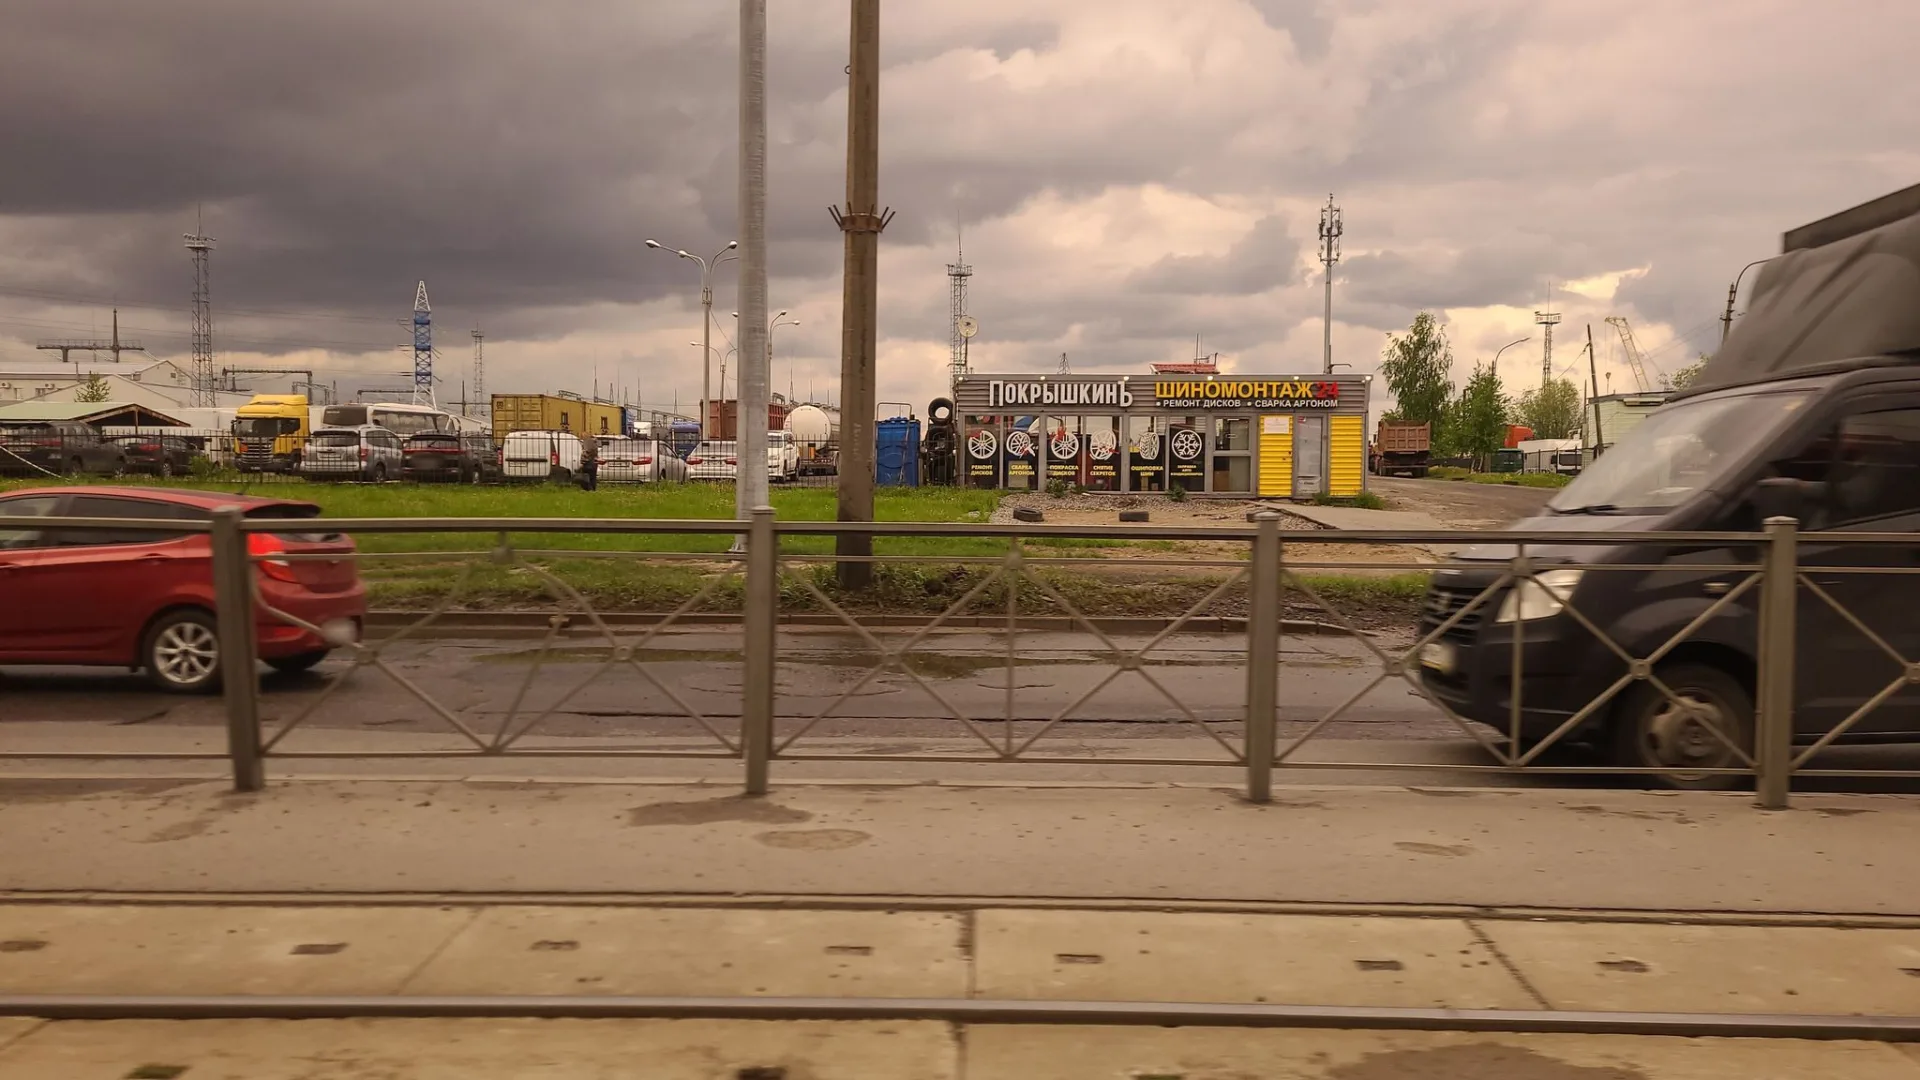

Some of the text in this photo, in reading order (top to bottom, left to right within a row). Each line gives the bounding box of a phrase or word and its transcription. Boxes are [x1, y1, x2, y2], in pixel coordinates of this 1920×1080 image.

[989, 380, 1134, 407] ПОКРЫШКИНЪ
[1155, 381, 1340, 399] ШИНОМОНТАЖ 24
[1163, 399, 1242, 409] РЕМОНТ ДИСКОВ
[1254, 399, 1339, 408] СВАРКА АРГОНОМ
